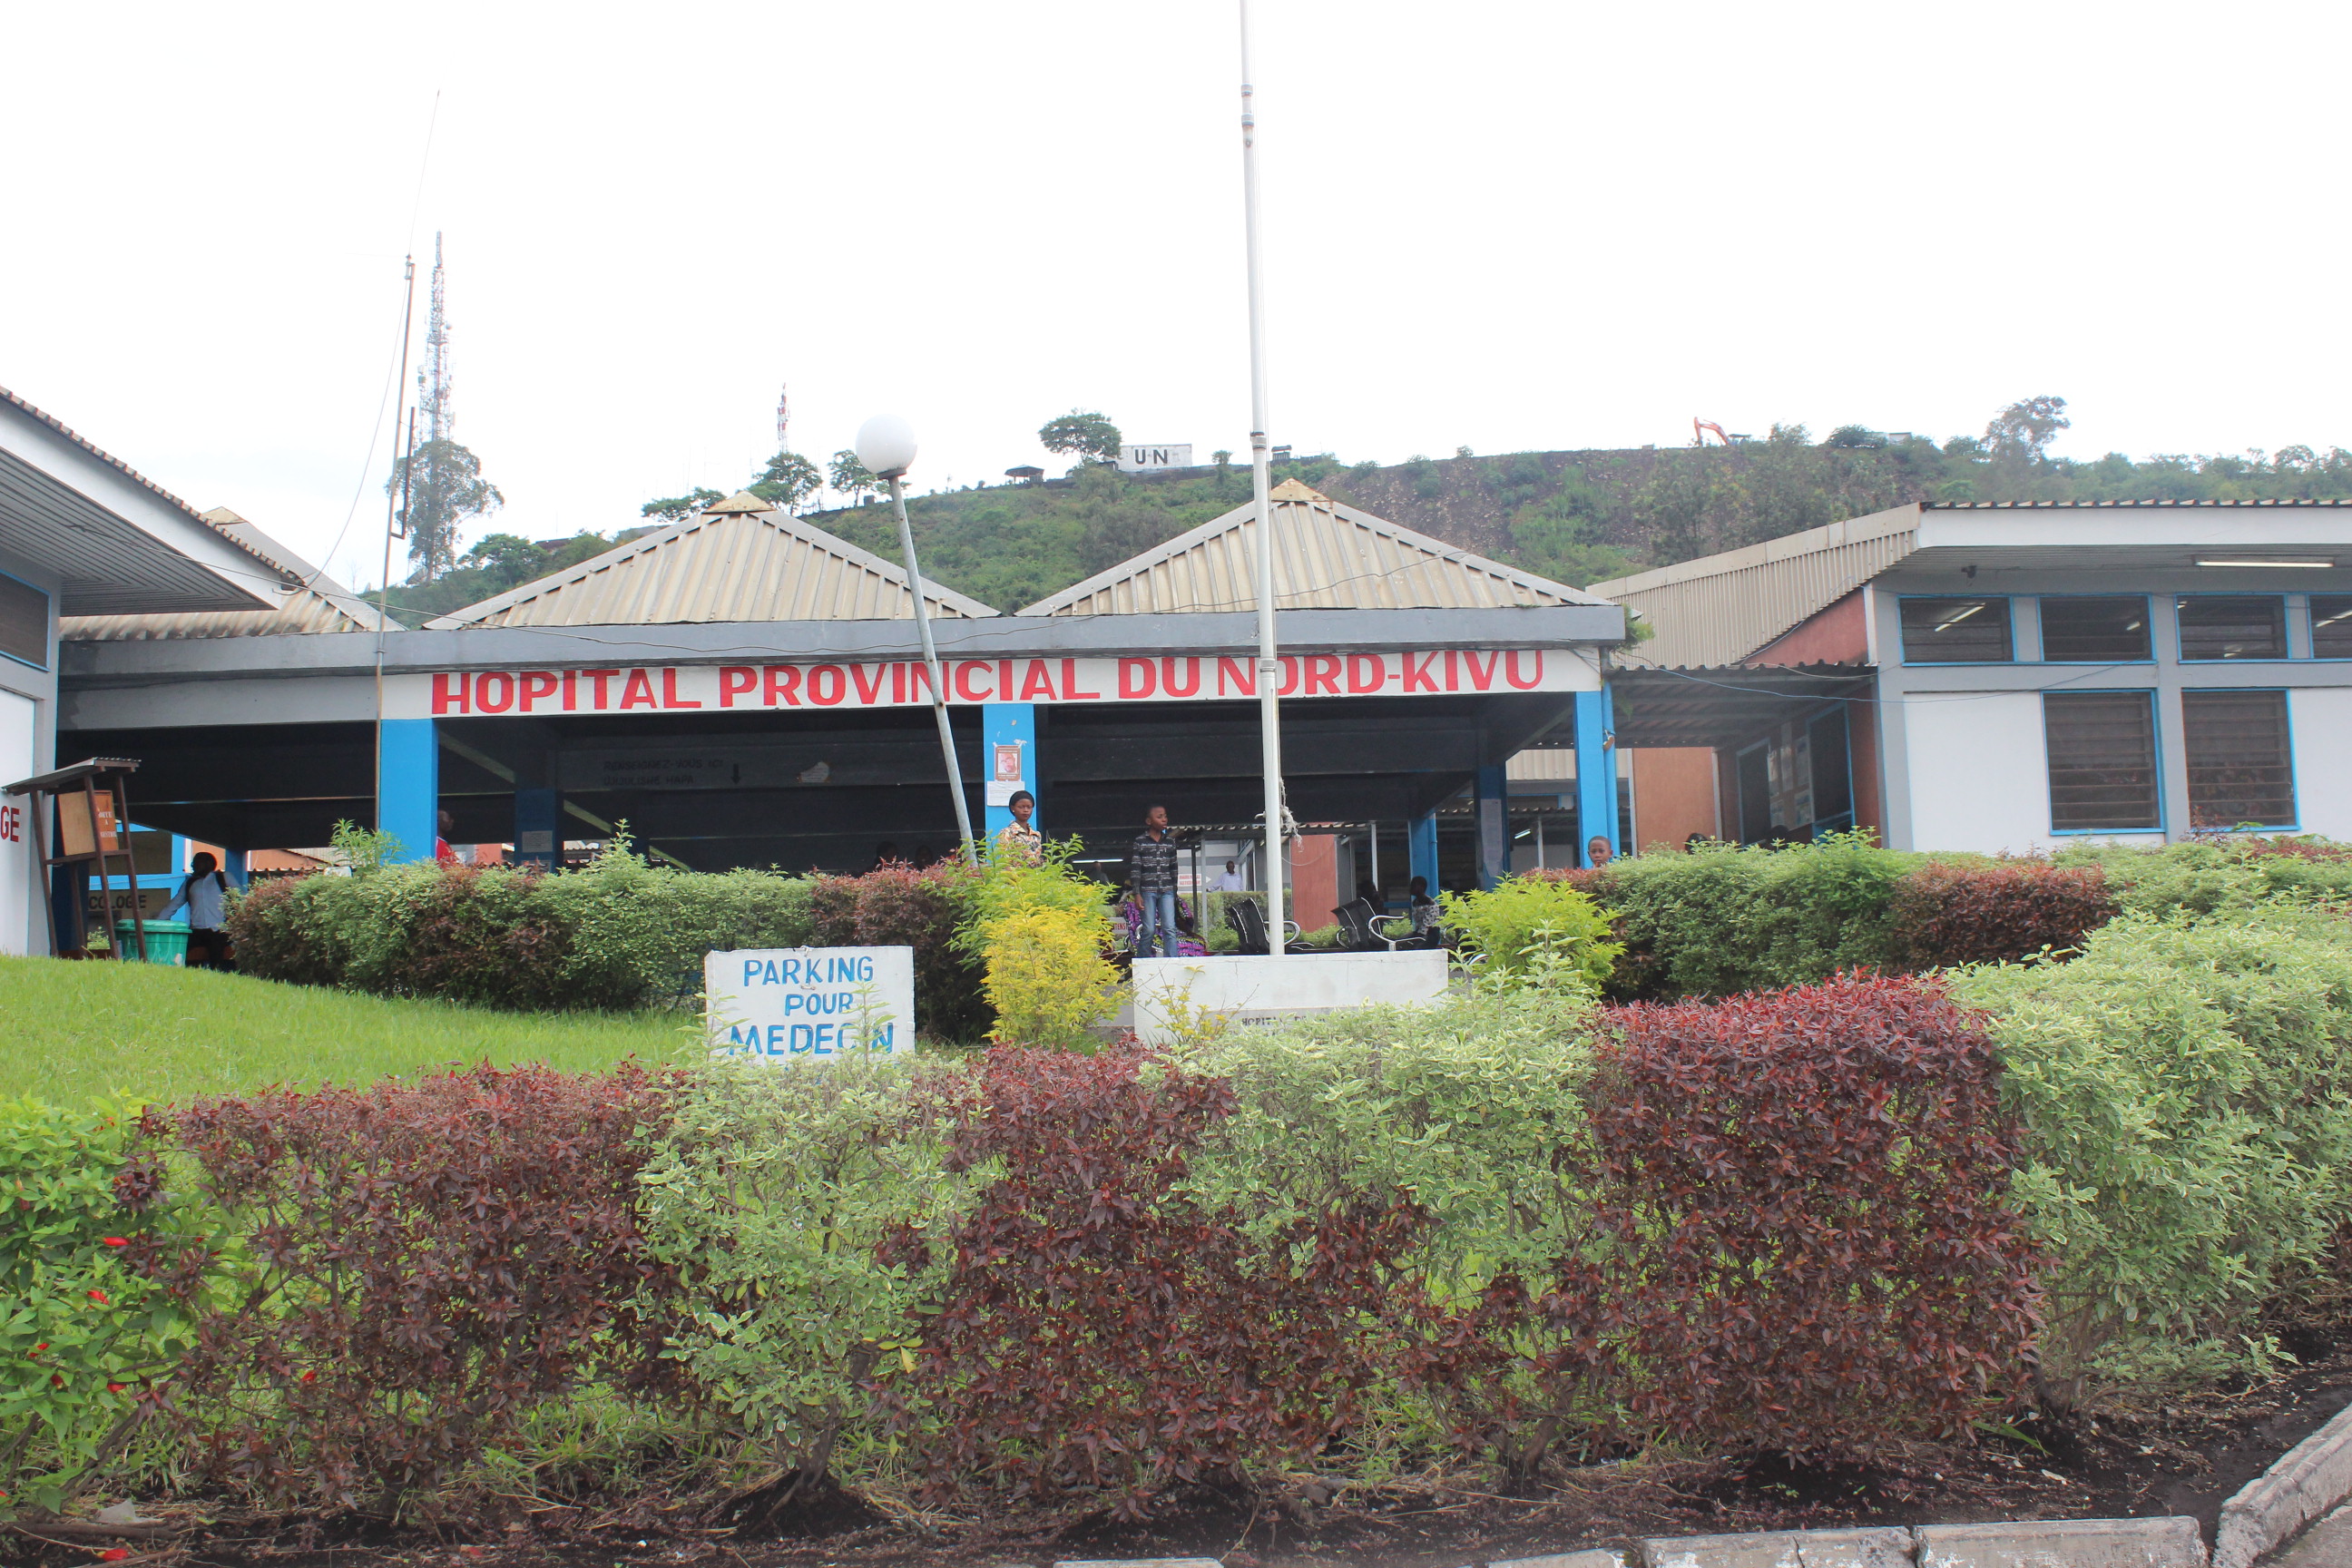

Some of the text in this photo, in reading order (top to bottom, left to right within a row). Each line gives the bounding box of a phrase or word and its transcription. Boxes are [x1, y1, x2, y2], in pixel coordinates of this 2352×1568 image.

[1134, 448, 1168, 465] UN
[431, 649, 1543, 714] HOPITAL PROVINCIAL DU NORD-KIVU
[1, 805, 20, 842] GE
[743, 956, 874, 987] PARKING
[784, 992, 855, 1017] POUR
[729, 1022, 894, 1056] MEDECN
